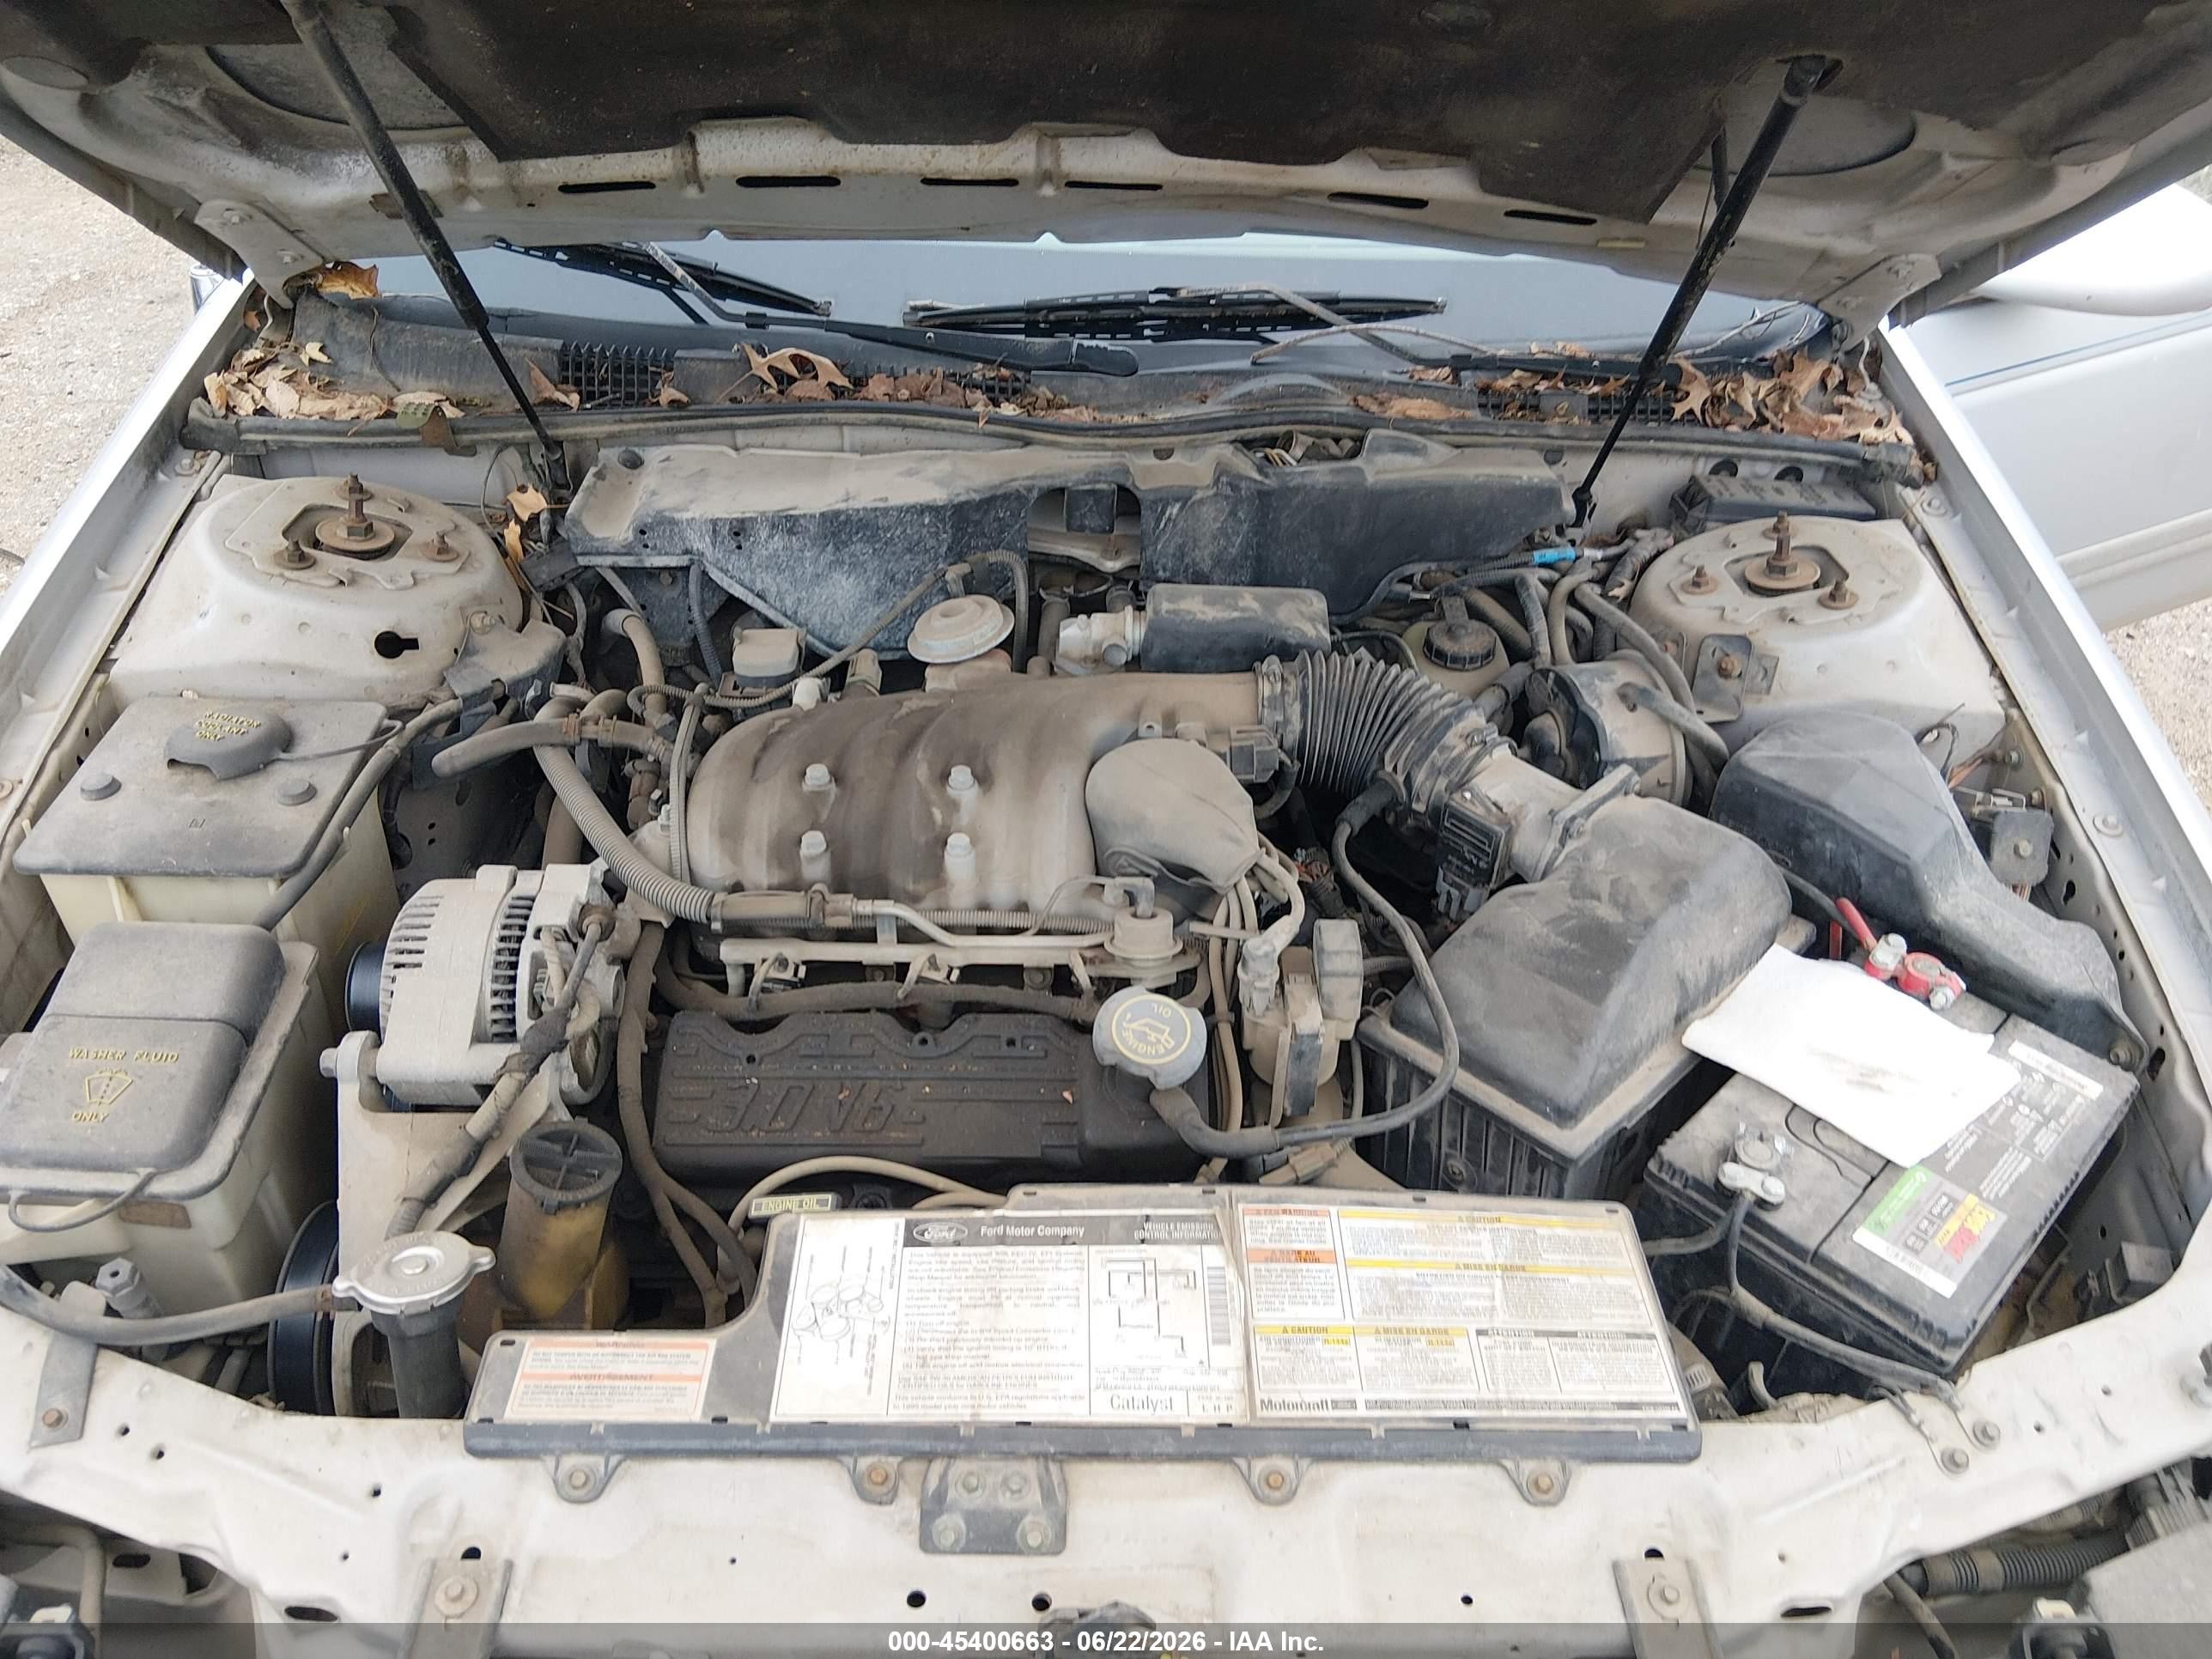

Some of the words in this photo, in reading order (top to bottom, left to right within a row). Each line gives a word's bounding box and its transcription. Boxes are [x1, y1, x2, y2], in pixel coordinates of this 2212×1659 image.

[196, 731, 225, 742] ONLY
[1152, 1003, 1171, 1018] OIL
[1122, 1030, 1165, 1056] ENGINE
[69, 1047, 127, 1060] WASHER
[134, 1050, 179, 1063] FLUID
[72, 1112, 109, 1122] ONLY
[762, 1199, 799, 1212] ENGINE
[803, 1197, 818, 1210] OIL
[981, 1225, 1003, 1237] Ford
[1006, 1226, 1036, 1237] Motor
[1037, 1224, 1085, 1238] Company
[1110, 1393, 1173, 1413] Catalyst
[1259, 1398, 1329, 1412] Motorcraft
